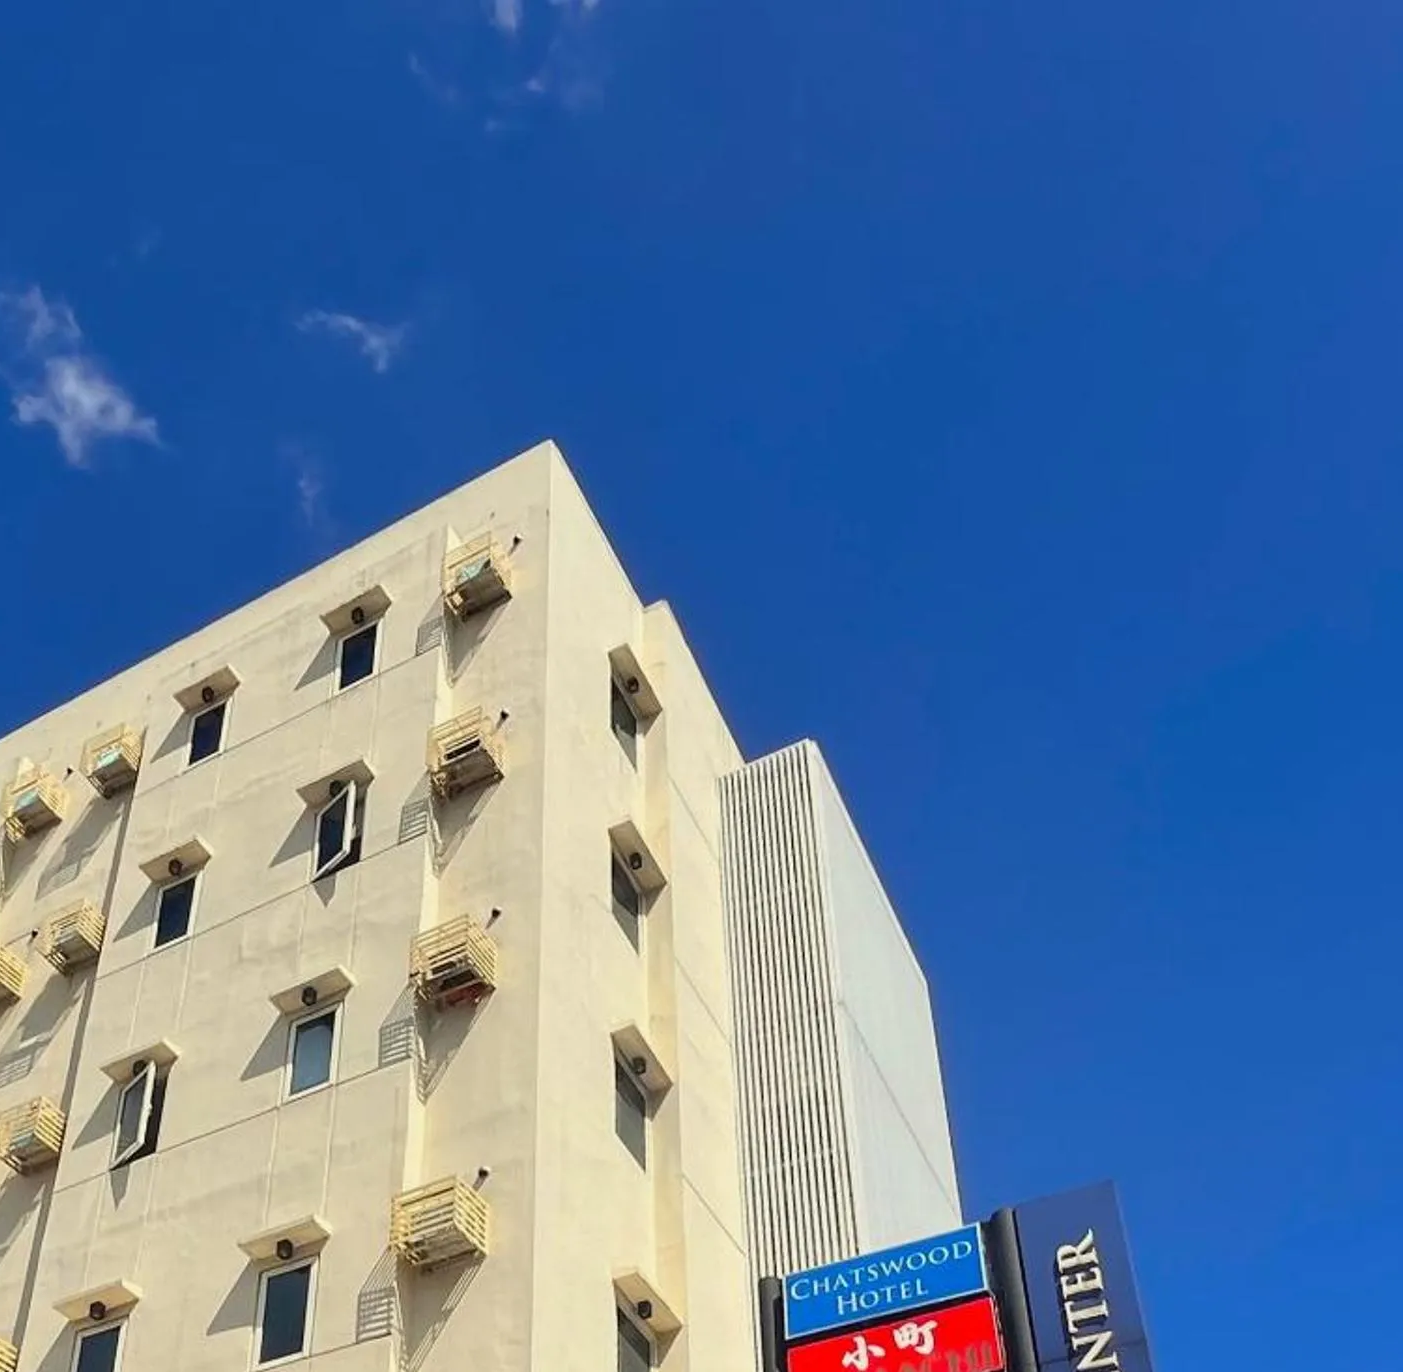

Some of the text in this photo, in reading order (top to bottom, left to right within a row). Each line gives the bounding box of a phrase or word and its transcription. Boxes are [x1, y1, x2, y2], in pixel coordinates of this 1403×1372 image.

[790, 1240, 972, 1301] CHATSWOOD
[836, 1277, 929, 1316] HOTEL
[841, 1319, 938, 1371] 小町
